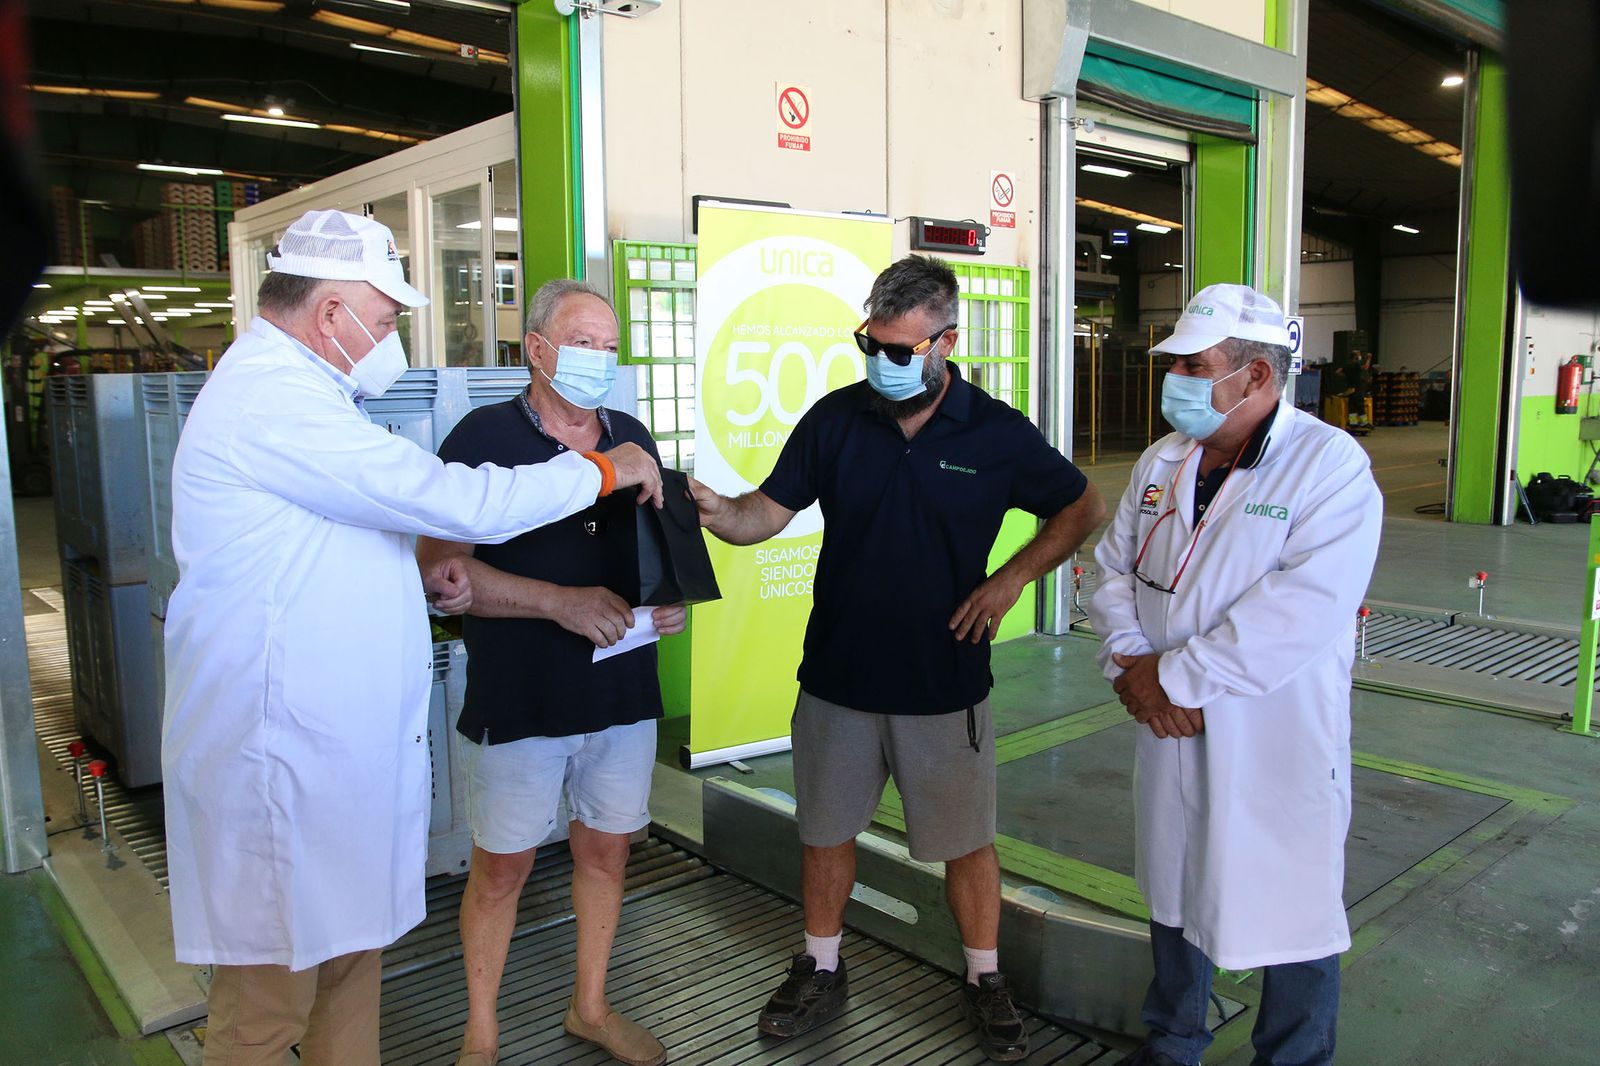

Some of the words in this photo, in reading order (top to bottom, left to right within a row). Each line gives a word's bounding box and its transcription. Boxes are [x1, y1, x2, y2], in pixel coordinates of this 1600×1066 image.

[779, 134, 809, 144] PROHIBIDO
[785, 141, 804, 149] FUMAR
[732, 323, 771, 337] HEMOS
[773, 324, 835, 338] ALCANZADO
[725, 341, 866, 427] 500
[728, 430, 790, 449] MILLON
[755, 544, 821, 565] SIGAMOS
[760, 562, 815, 582] SIENDO
[759, 579, 814, 600] ÚNICOS
